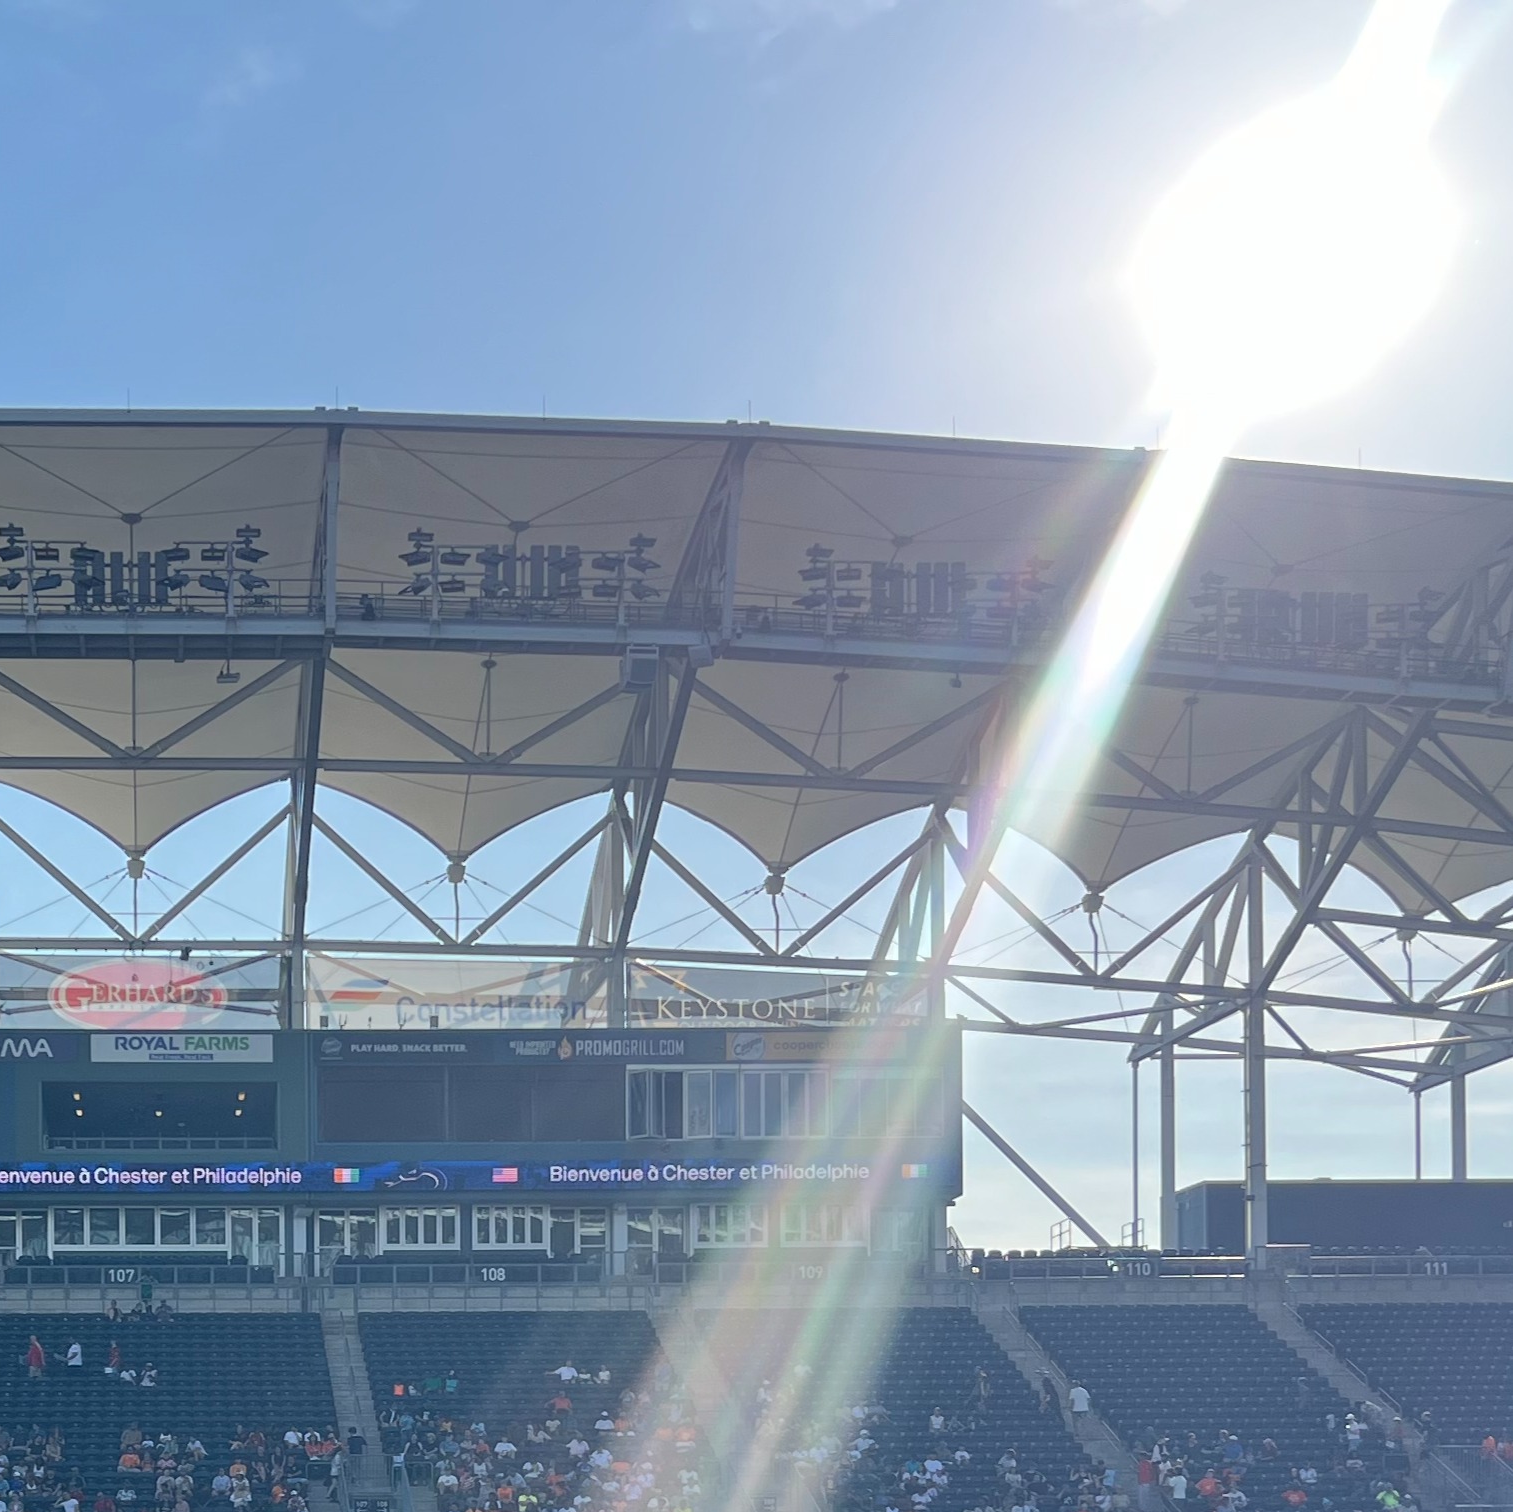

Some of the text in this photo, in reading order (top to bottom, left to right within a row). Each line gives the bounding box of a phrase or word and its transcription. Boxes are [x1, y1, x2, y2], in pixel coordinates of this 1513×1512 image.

[396, 995, 587, 1023] Constellation
[656, 996, 817, 1020] KEYSTONE
[115, 1036, 250, 1051] ROYAL FARMS
[350, 1044, 373, 1052] PLAY
[575, 1039, 685, 1056] PROMOGRILL.COM
[79, 1168, 89, 1184] à
[94, 1167, 167, 1184] Chester
[171, 1169, 189, 1184] et
[193, 1167, 302, 1187] Philadelphie
[549, 1163, 870, 1183] Bienvenue à Chester et Philadelphie
[108, 1269, 135, 1283] 107
[481, 1267, 506, 1281] 108
[799, 1265, 823, 1279] 109
[1127, 1262, 1151, 1276] 110
[1424, 1262, 1448, 1276] 111
